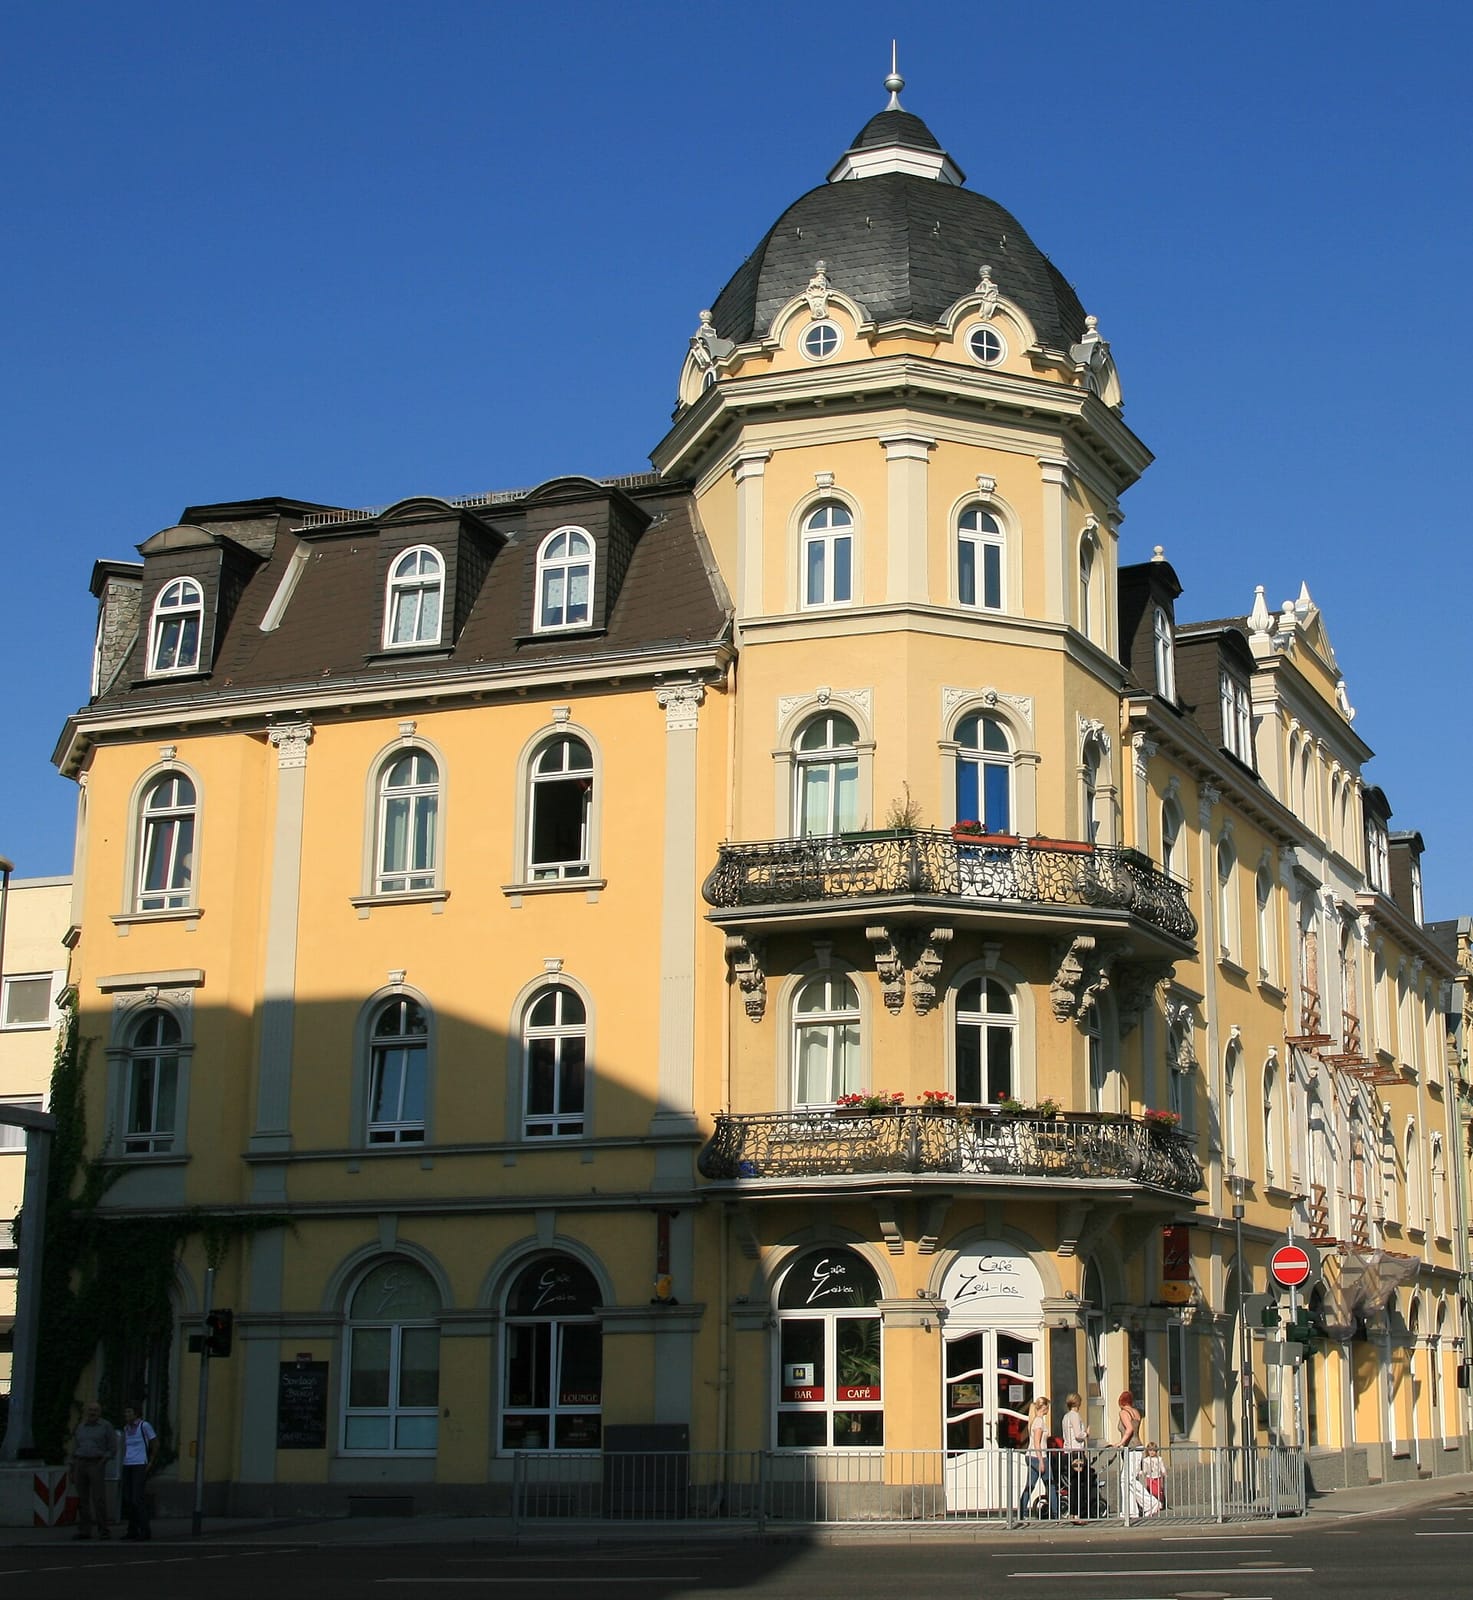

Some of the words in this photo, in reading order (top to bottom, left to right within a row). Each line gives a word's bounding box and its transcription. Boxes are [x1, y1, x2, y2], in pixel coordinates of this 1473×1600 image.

[978, 1255, 1012, 1272] Café
[794, 1390, 812, 1399] BAR
[847, 1387, 871, 1399] CAFÉ
